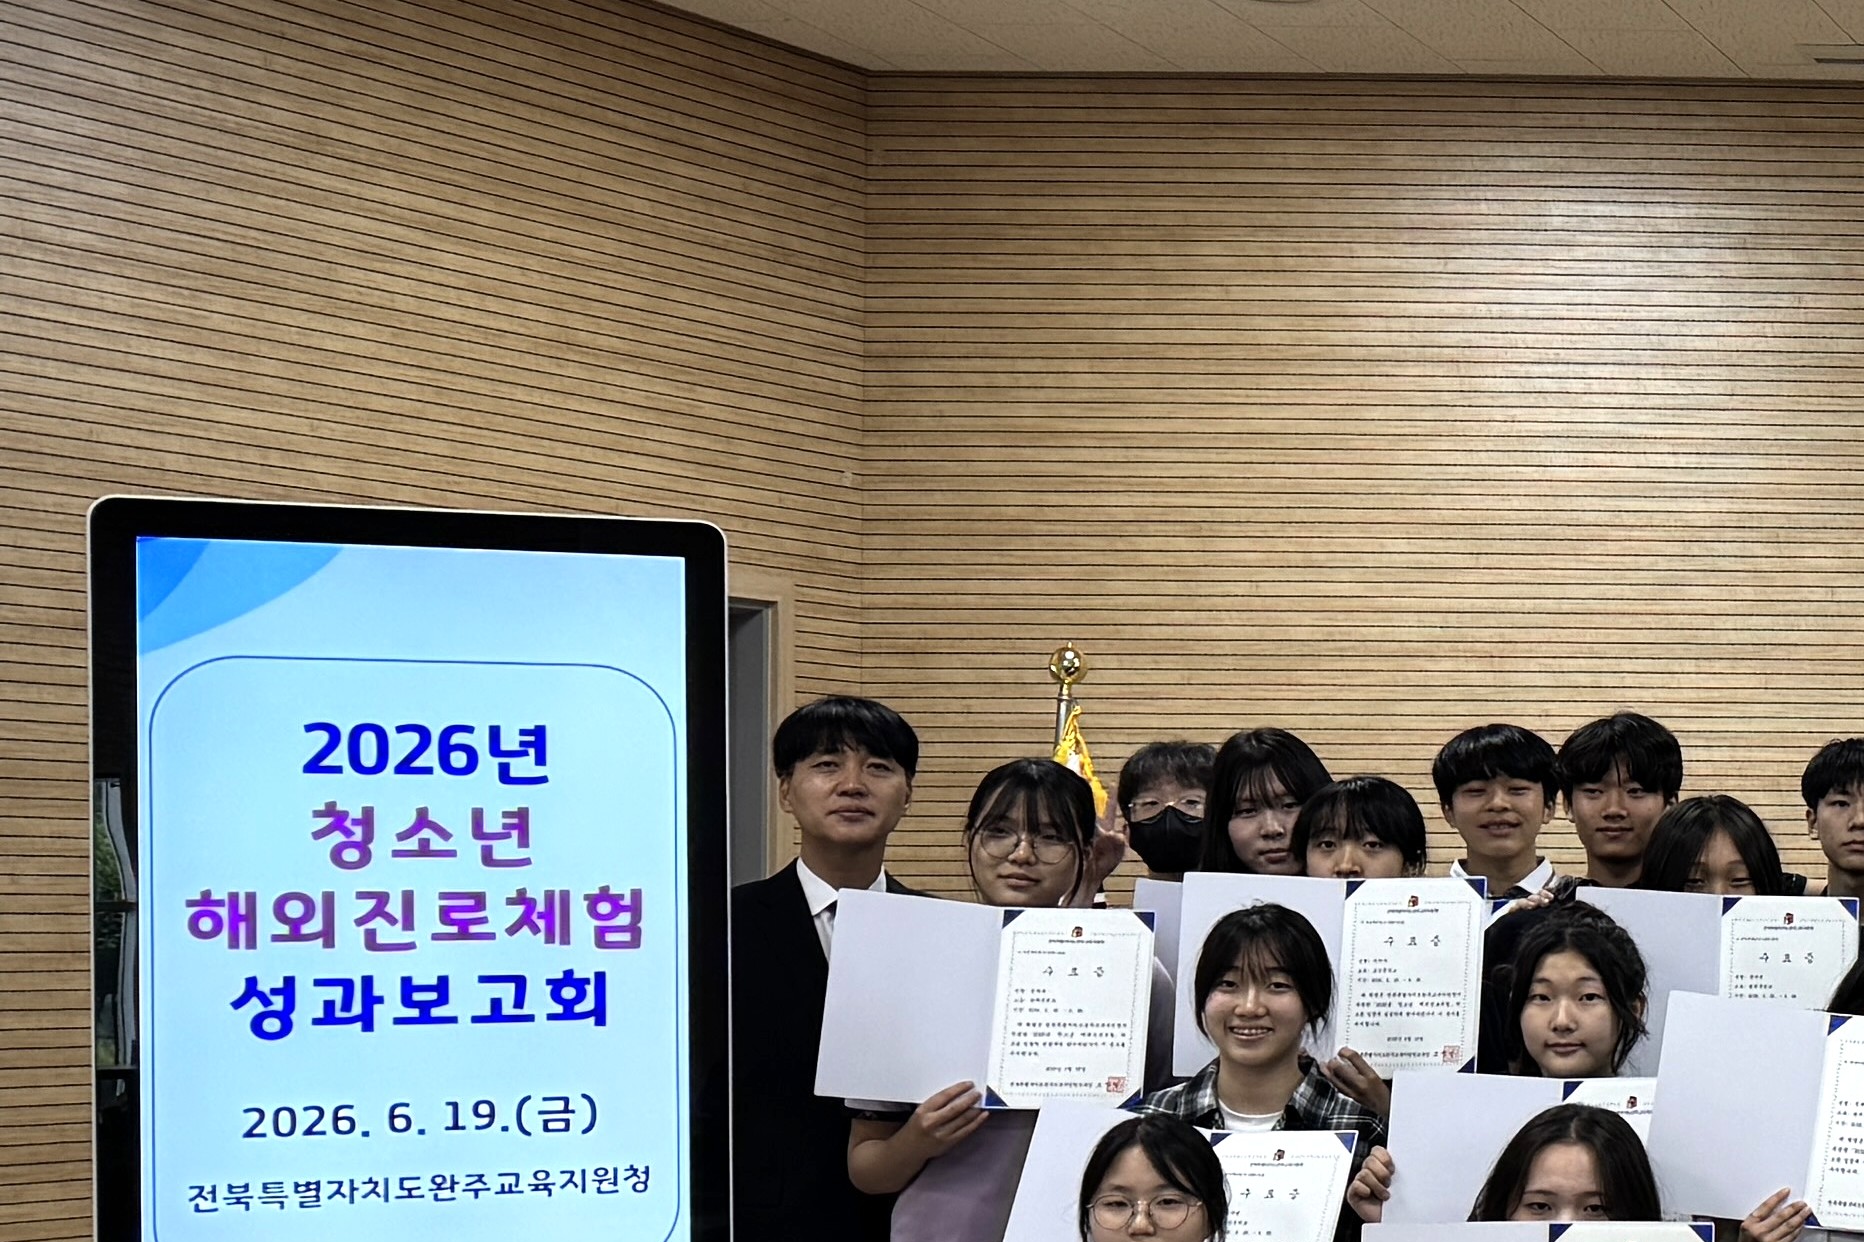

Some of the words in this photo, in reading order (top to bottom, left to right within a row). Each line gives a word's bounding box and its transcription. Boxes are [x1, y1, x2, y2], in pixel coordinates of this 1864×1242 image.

[303, 722, 549, 785] 2026년
[311, 801, 532, 870] 청소년
[186, 885, 643, 951] 해외진로체험
[230, 969, 606, 1041] 성과보고회
[242, 1105, 370, 1138] 2026.
[388, 1102, 426, 1136] 6.
[444, 1093, 598, 1137] 19.(금)
[187, 1163, 651, 1213] 전북특별자치도완주교육지원청
